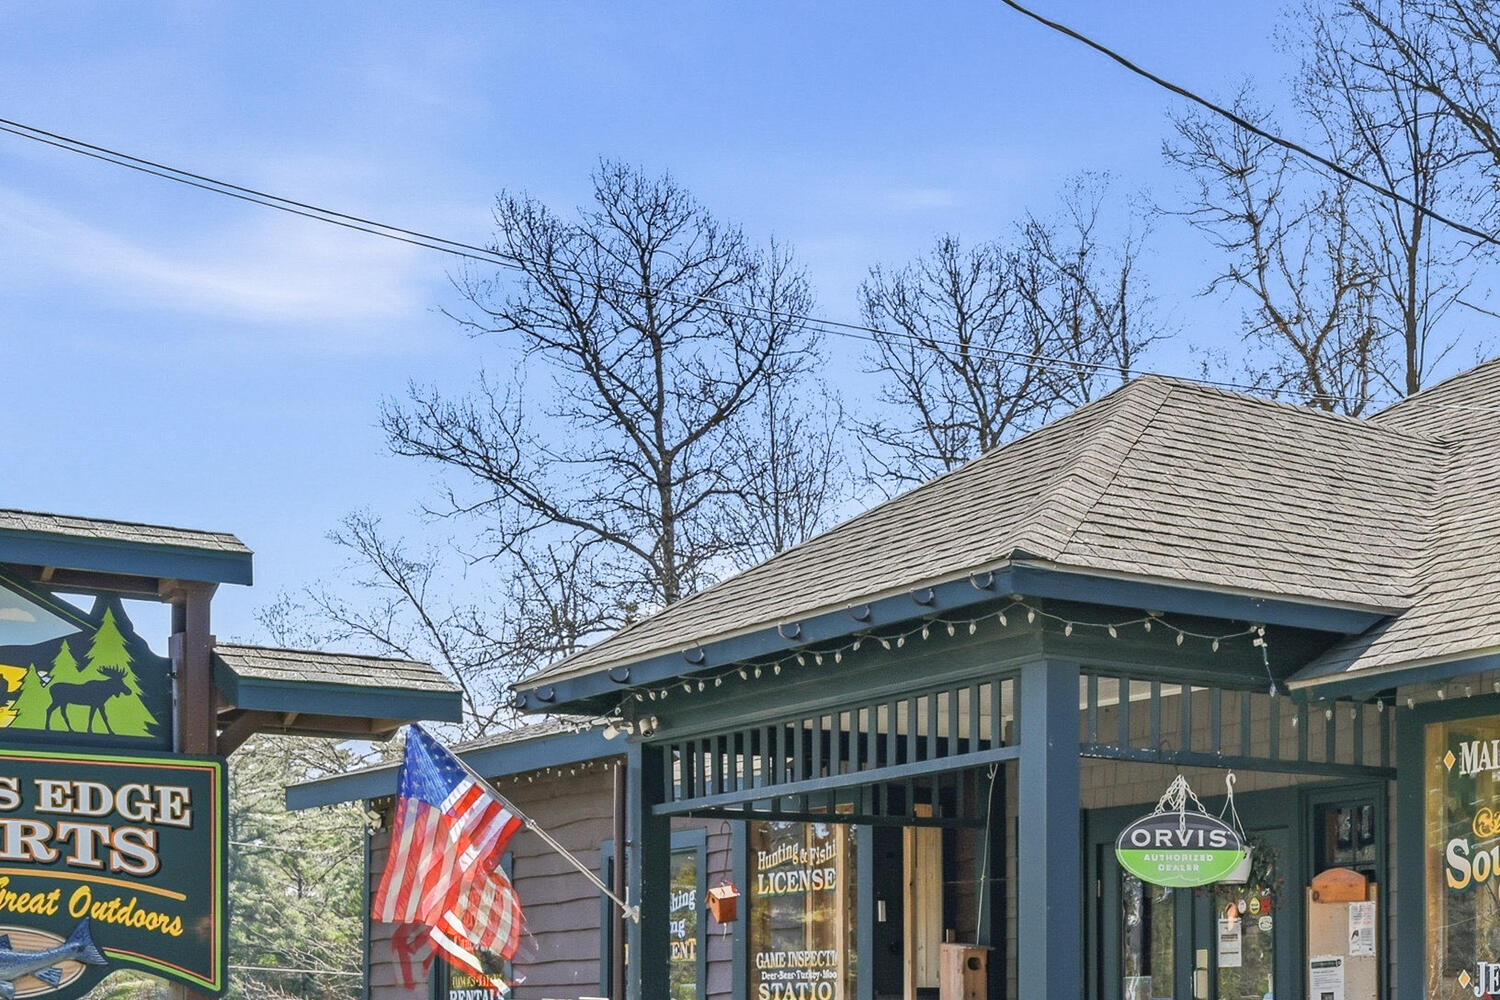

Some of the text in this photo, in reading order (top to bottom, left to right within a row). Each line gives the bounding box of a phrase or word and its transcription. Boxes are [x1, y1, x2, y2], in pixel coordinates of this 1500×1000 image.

[34, 779, 192, 828] EDGE
[1131, 828, 1227, 848] ORVIS
[758, 840, 837, 870] Hunting & Fishi
[1158, 864, 1200, 872] DEALER
[68, 885, 184, 937] Outdoors
[756, 952, 786, 969] GAME
